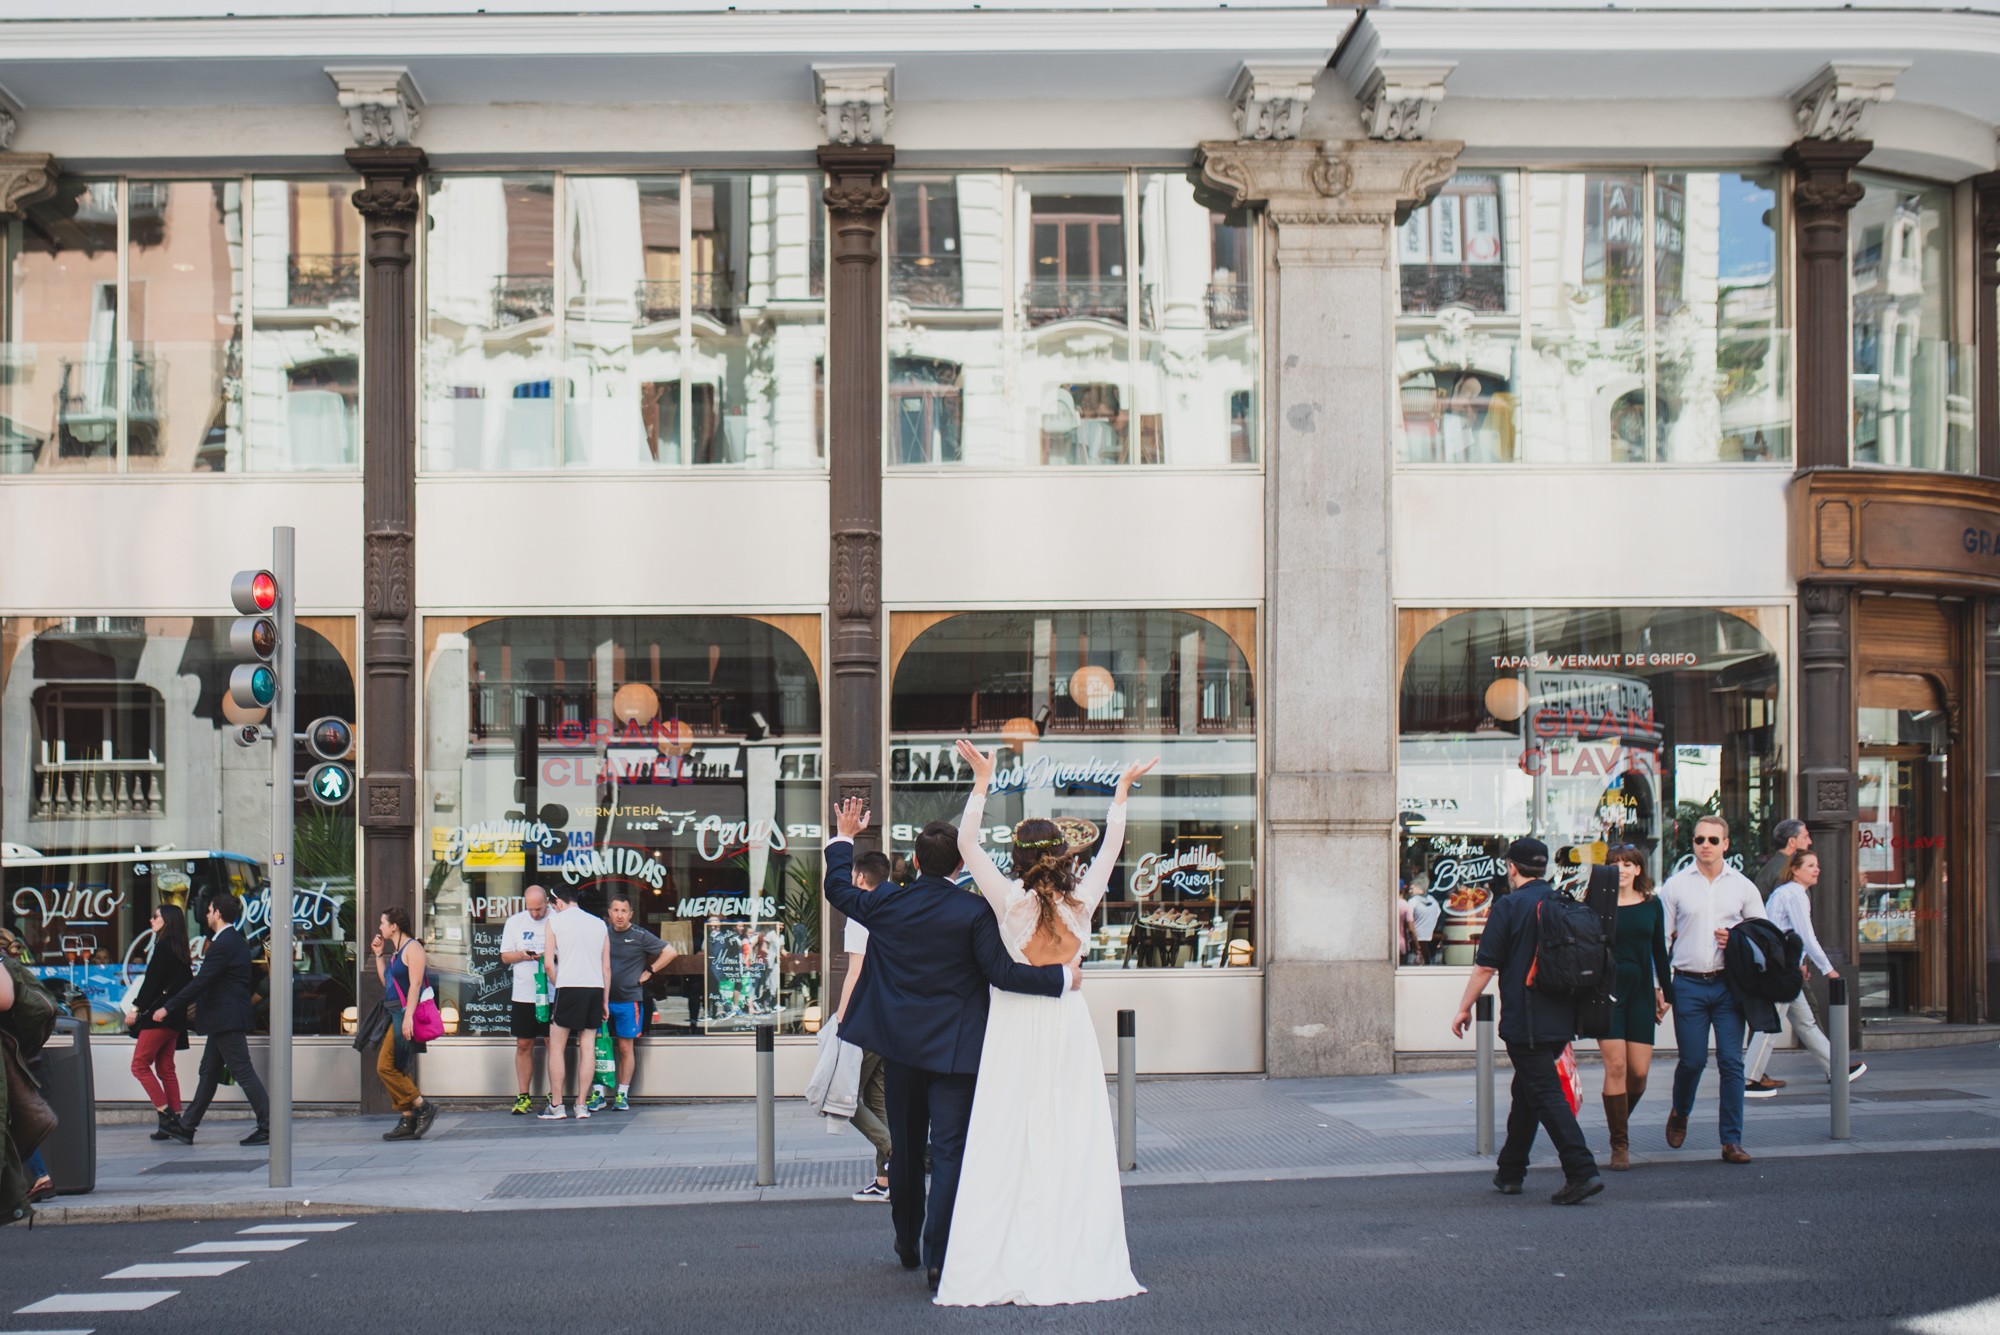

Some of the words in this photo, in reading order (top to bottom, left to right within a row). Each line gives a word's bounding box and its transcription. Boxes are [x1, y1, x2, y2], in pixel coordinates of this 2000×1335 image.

[1491, 655, 1540, 668] TAPAS
[1545, 655, 1554, 667] Y
[1557, 653, 1621, 668] VERMUT
[1625, 653, 1646, 666] DE
[1649, 652, 1698, 666] GRIFO
[556, 717, 680, 747] GRAN
[1533, 709, 1655, 737] GRAN
[542, 755, 694, 787] CLAVEL
[1519, 746, 1668, 777] CLAVEL
[574, 804, 664, 817] VERMUTERÍA
[696, 814, 787, 860] Cenas
[1890, 835, 1947, 849] CLAVE
[562, 848, 667, 889] COMIDAS
[1130, 844, 1220, 897] Ensaladilla
[1171, 870, 1213, 895] Rusa
[12, 881, 125, 929] Vino
[233, 882, 330, 931] erut
[676, 896, 777, 919] MERIENDAS
